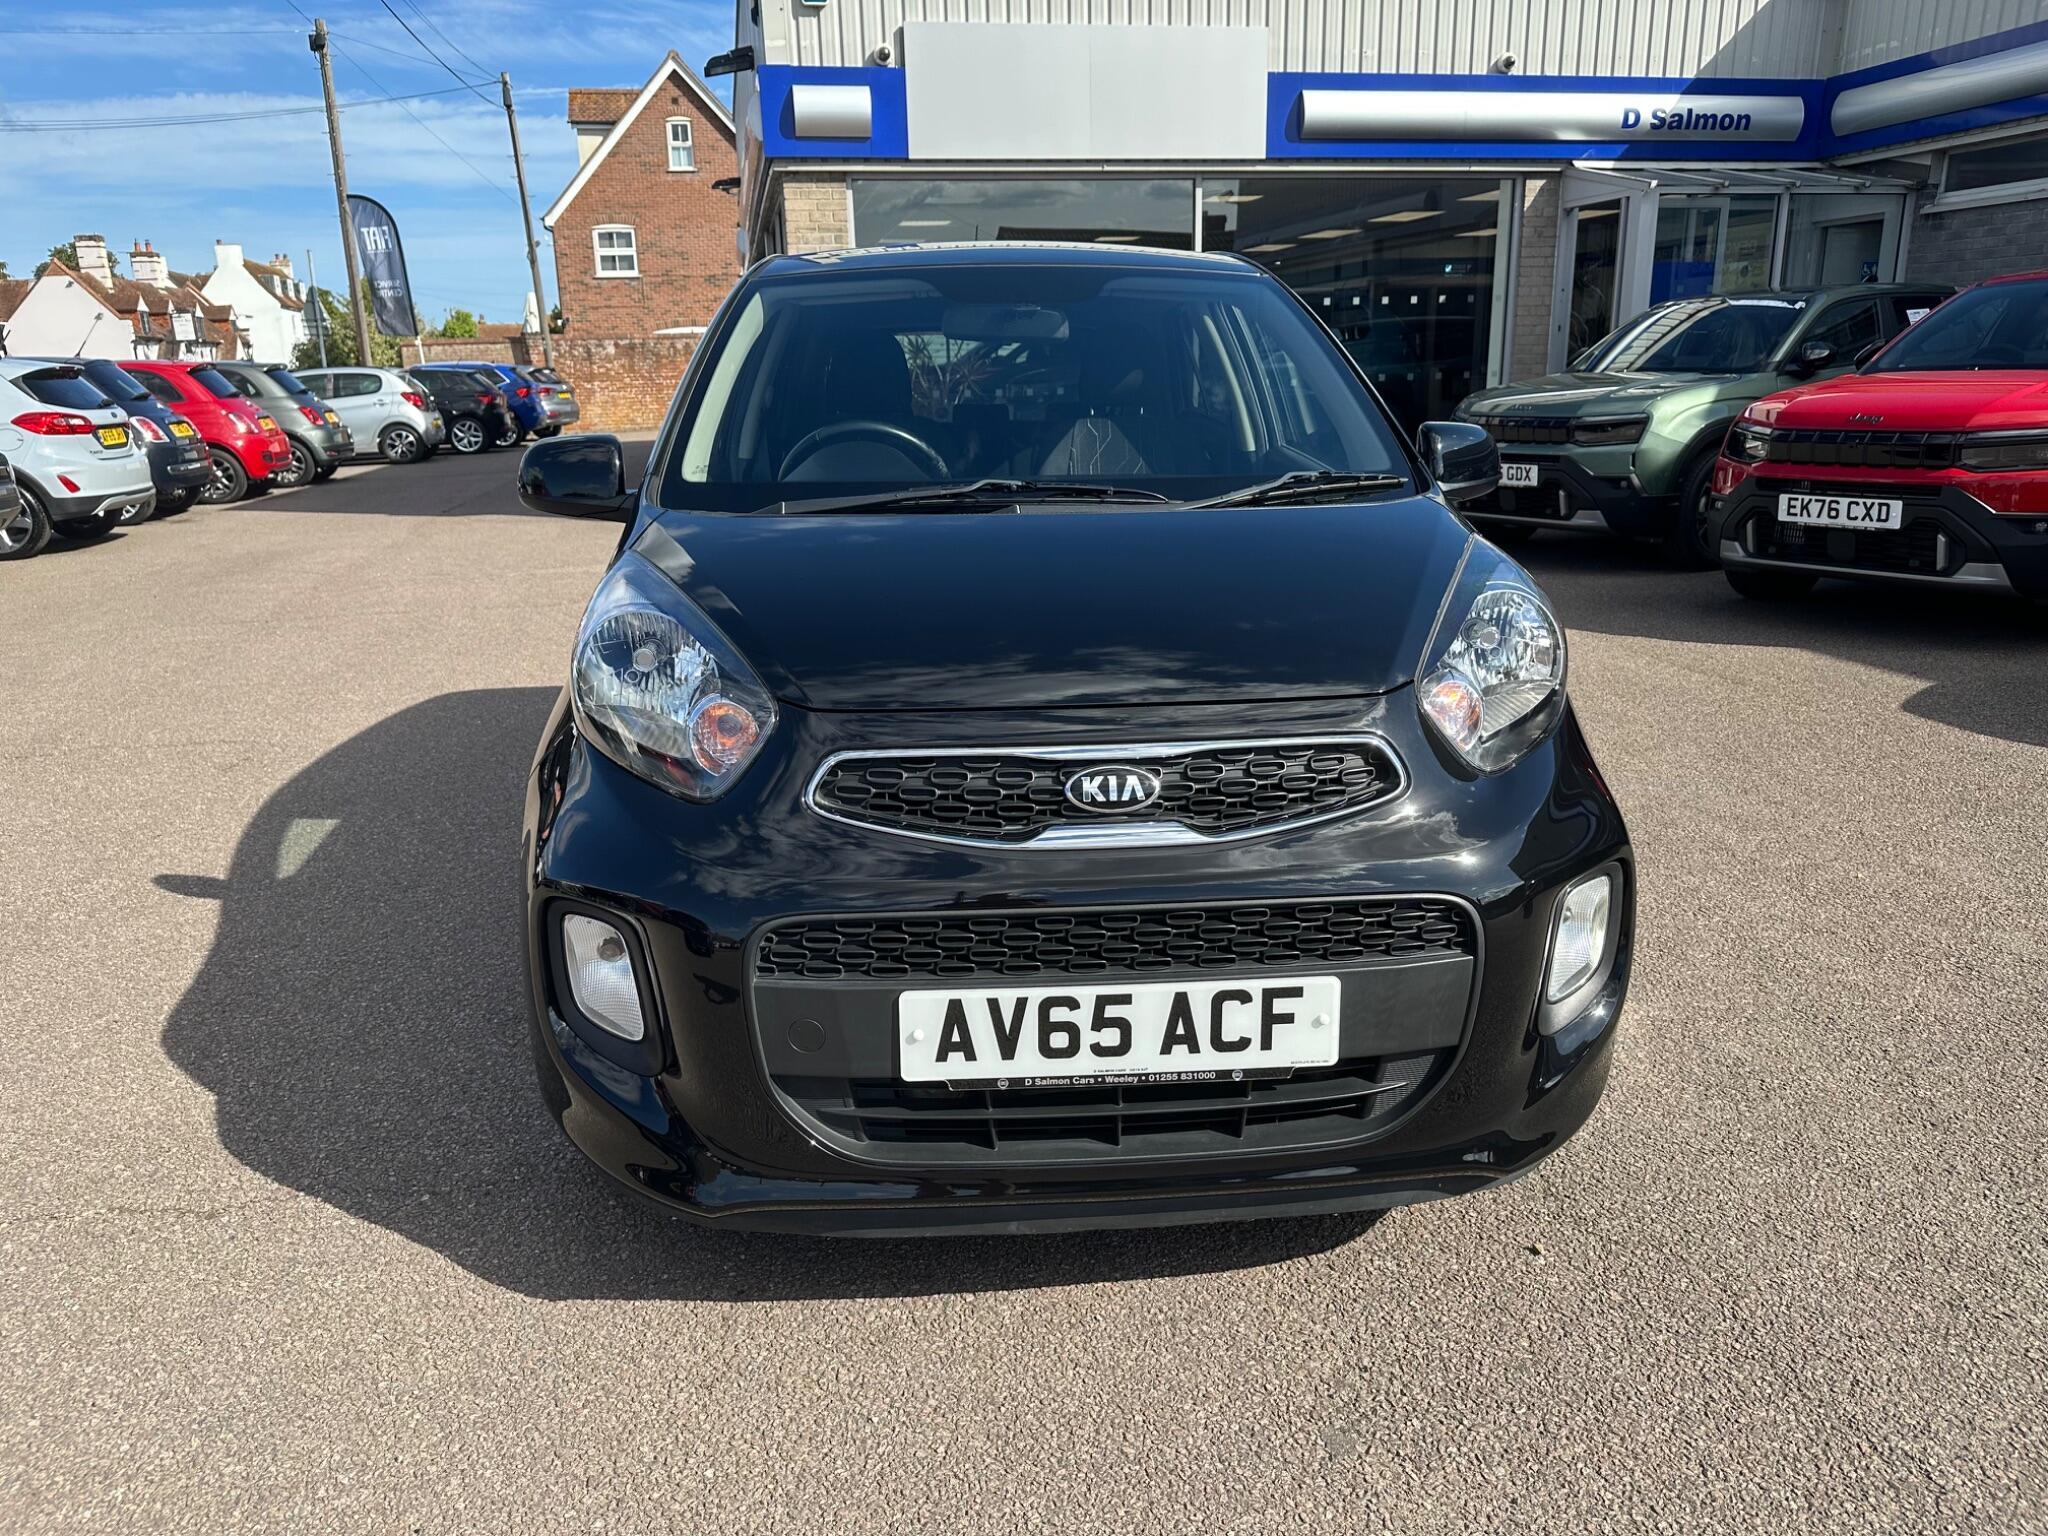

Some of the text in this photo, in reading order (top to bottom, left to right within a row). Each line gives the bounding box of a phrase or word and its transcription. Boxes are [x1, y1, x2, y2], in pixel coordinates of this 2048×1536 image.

[1621, 107, 1752, 131] D Salmon
[1506, 465, 1532, 482] GDX
[1786, 497, 1891, 523] EK76 CXD
[1081, 775, 1146, 802] KIA
[935, 986, 1304, 1063] AV65 ACF
[1024, 1071, 1216, 1086] D Salmon Cars Weeley 01255 831000
